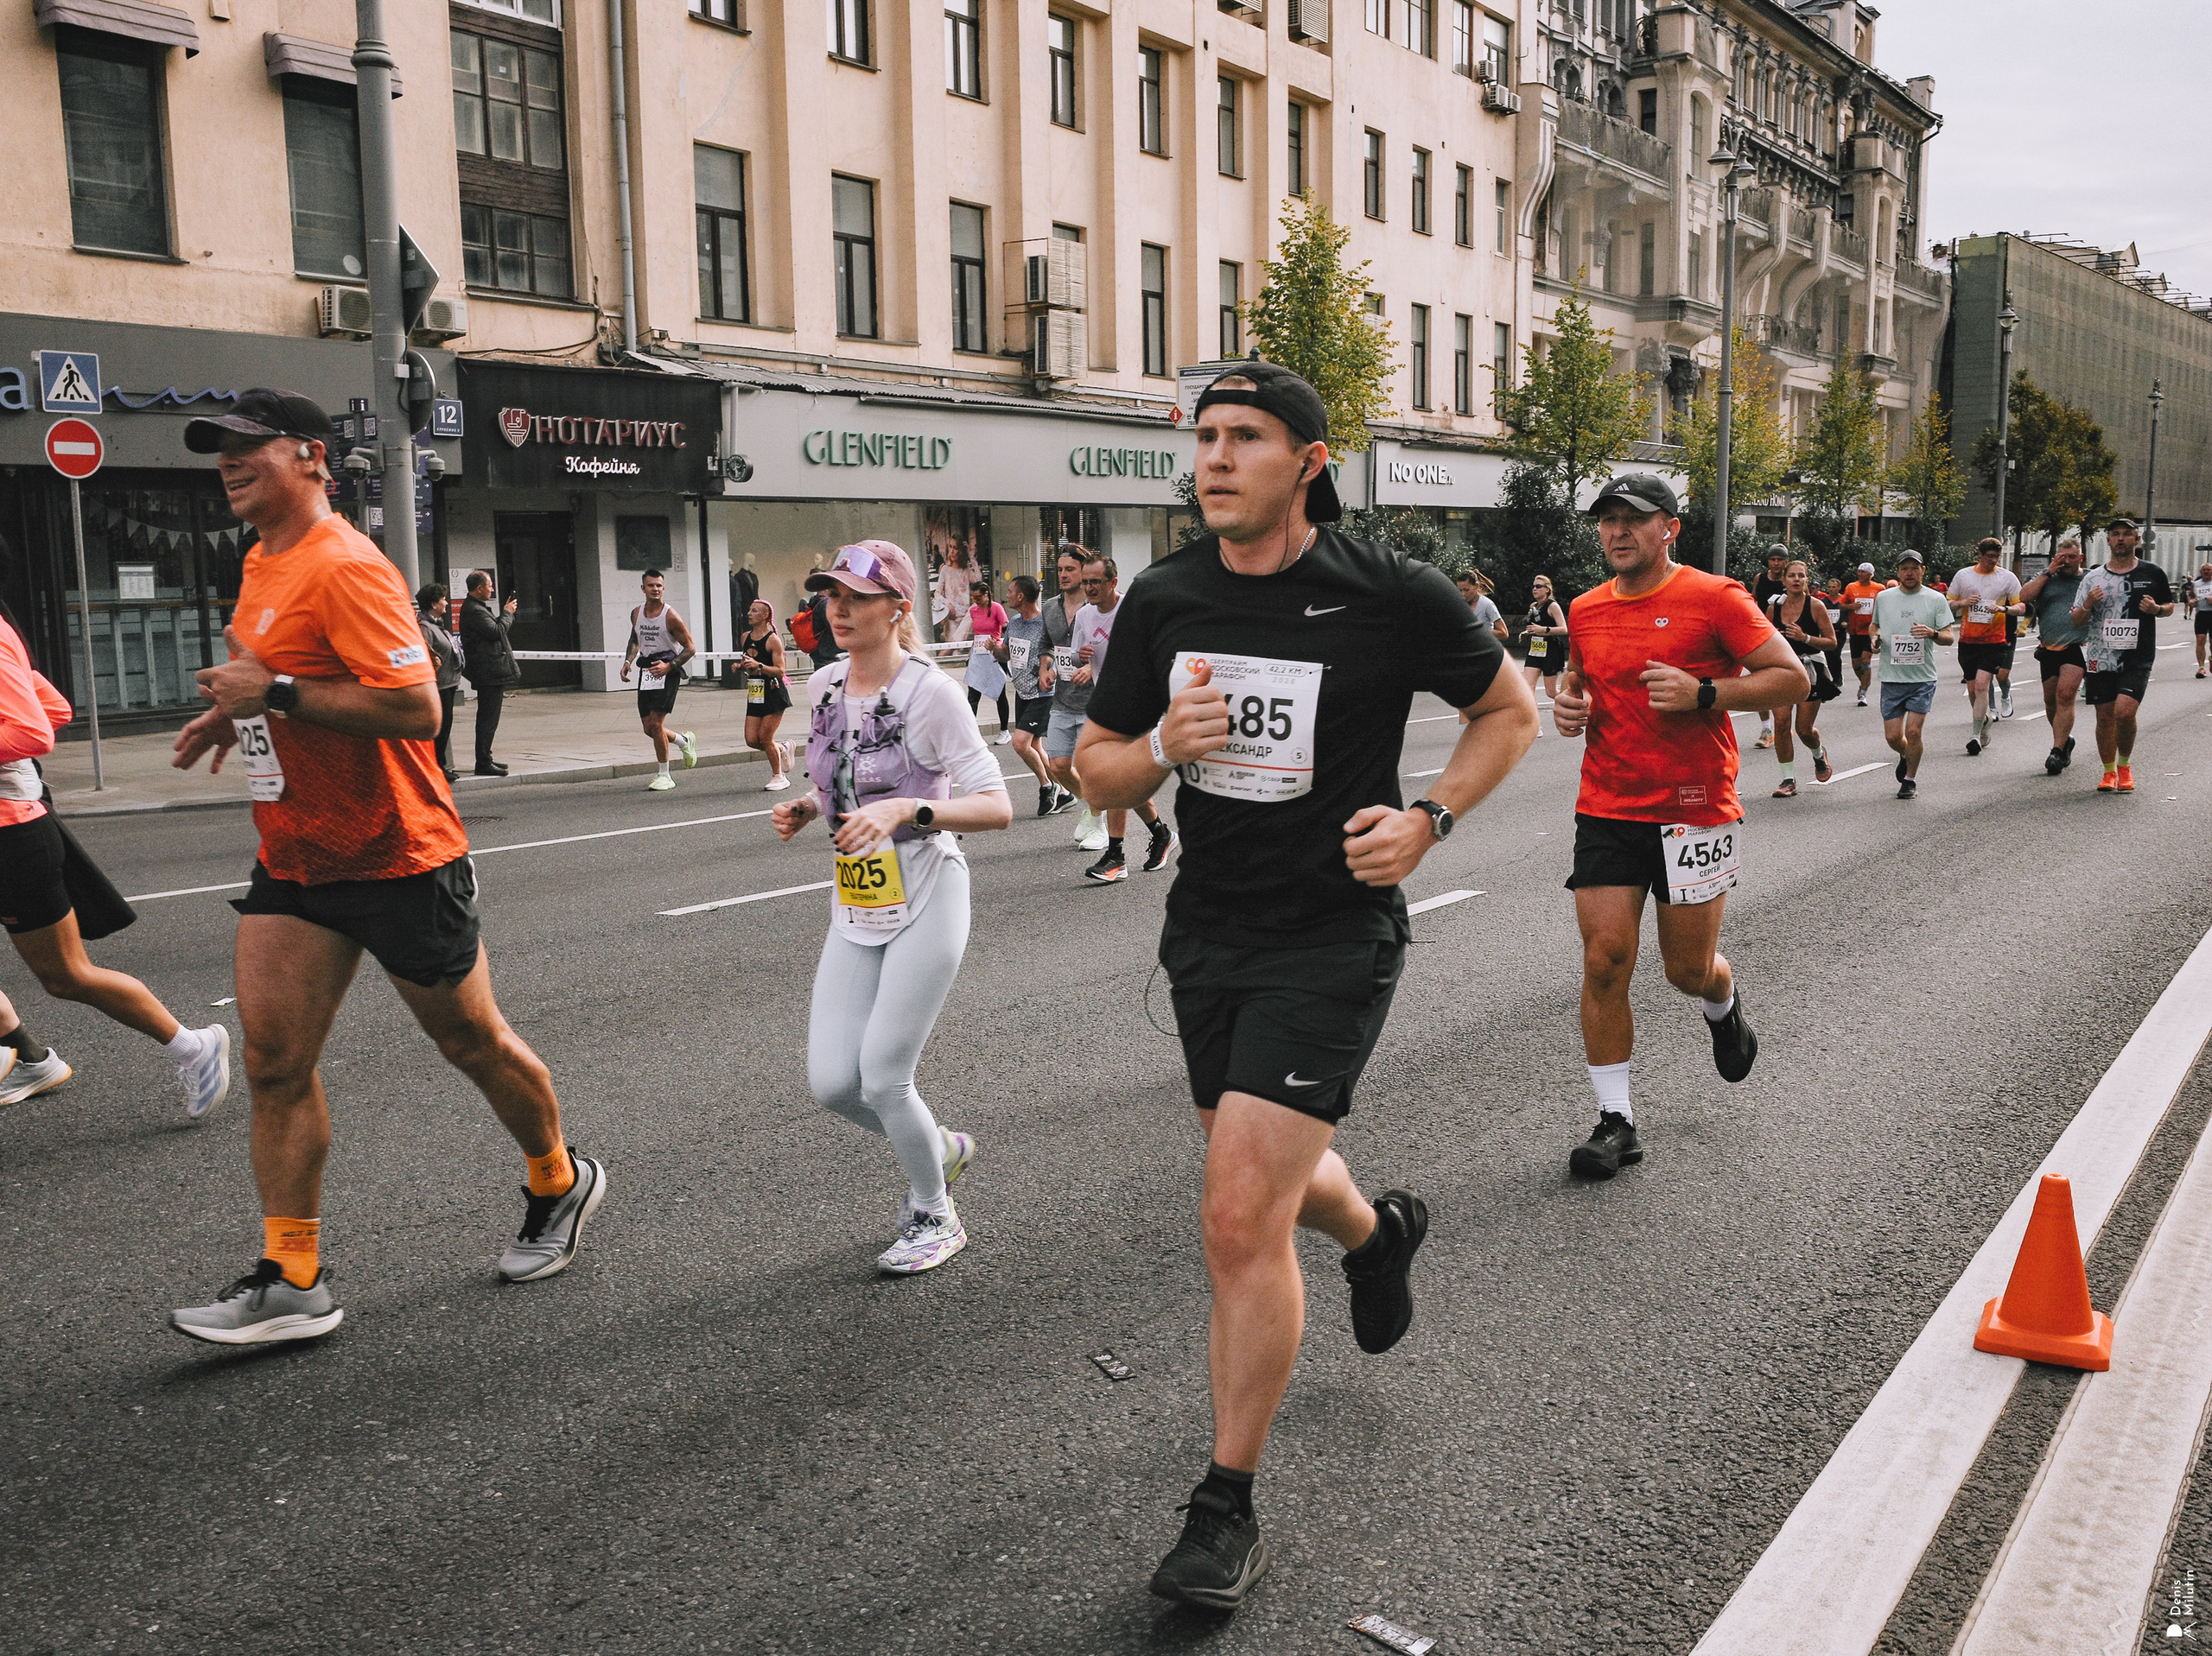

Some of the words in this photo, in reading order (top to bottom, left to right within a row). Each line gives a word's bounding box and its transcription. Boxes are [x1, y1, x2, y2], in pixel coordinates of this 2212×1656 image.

[438, 404, 457, 424] 12
[536, 416, 687, 448] НОТАРИУС
[804, 428, 951, 469] GLENFIELD
[564, 455, 640, 478] Кофейня
[1070, 446, 1177, 478] GLENFIELD
[1389, 462, 1414, 483] NO
[2105, 626, 2138, 637] 10073
[1010, 645, 1026, 656] 7699
[1895, 642, 1920, 652] 7752
[1677, 834, 1733, 869] 4563
[836, 858, 887, 890] 2025
[1699, 863, 1721, 878] СЕРГЕЙ
